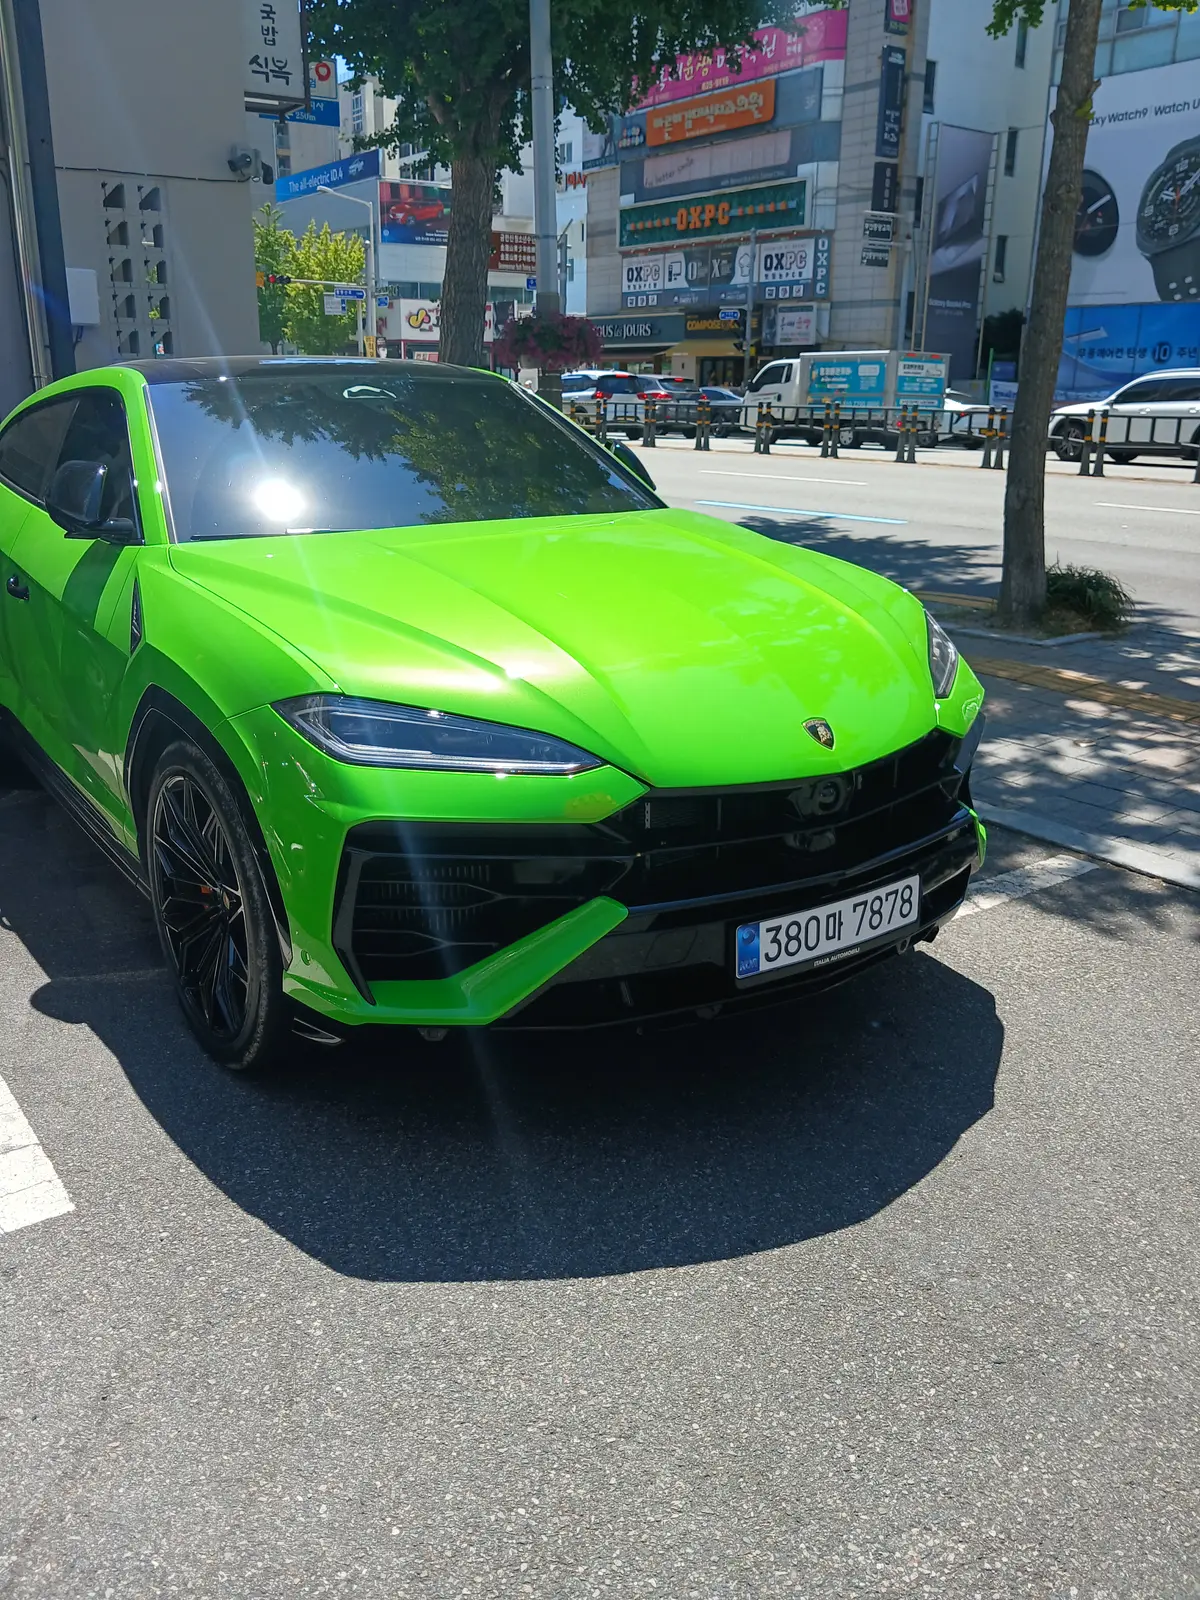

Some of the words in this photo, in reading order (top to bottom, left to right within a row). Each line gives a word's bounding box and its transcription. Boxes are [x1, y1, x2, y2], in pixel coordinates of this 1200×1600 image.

[260, 3, 278, 46] 국밥
[1108, 107, 1148, 123] Watch9
[1154, 101, 1190, 116] Watch
[289, 180, 300, 193] The
[300, 172, 330, 191] all-electric
[676, 201, 730, 231] OXPC
[763, 250, 807, 271] OXPC
[816, 238, 829, 295] OXPC
[626, 264, 660, 283] OXPC
[595, 324, 613, 338] OUS
[622, 323, 652, 340] JOURS
[686, 320, 720, 331] COMPOSE
[1154, 344, 1171, 361] 10
[764, 909, 844, 963] 380마
[852, 884, 914, 937] 7878
